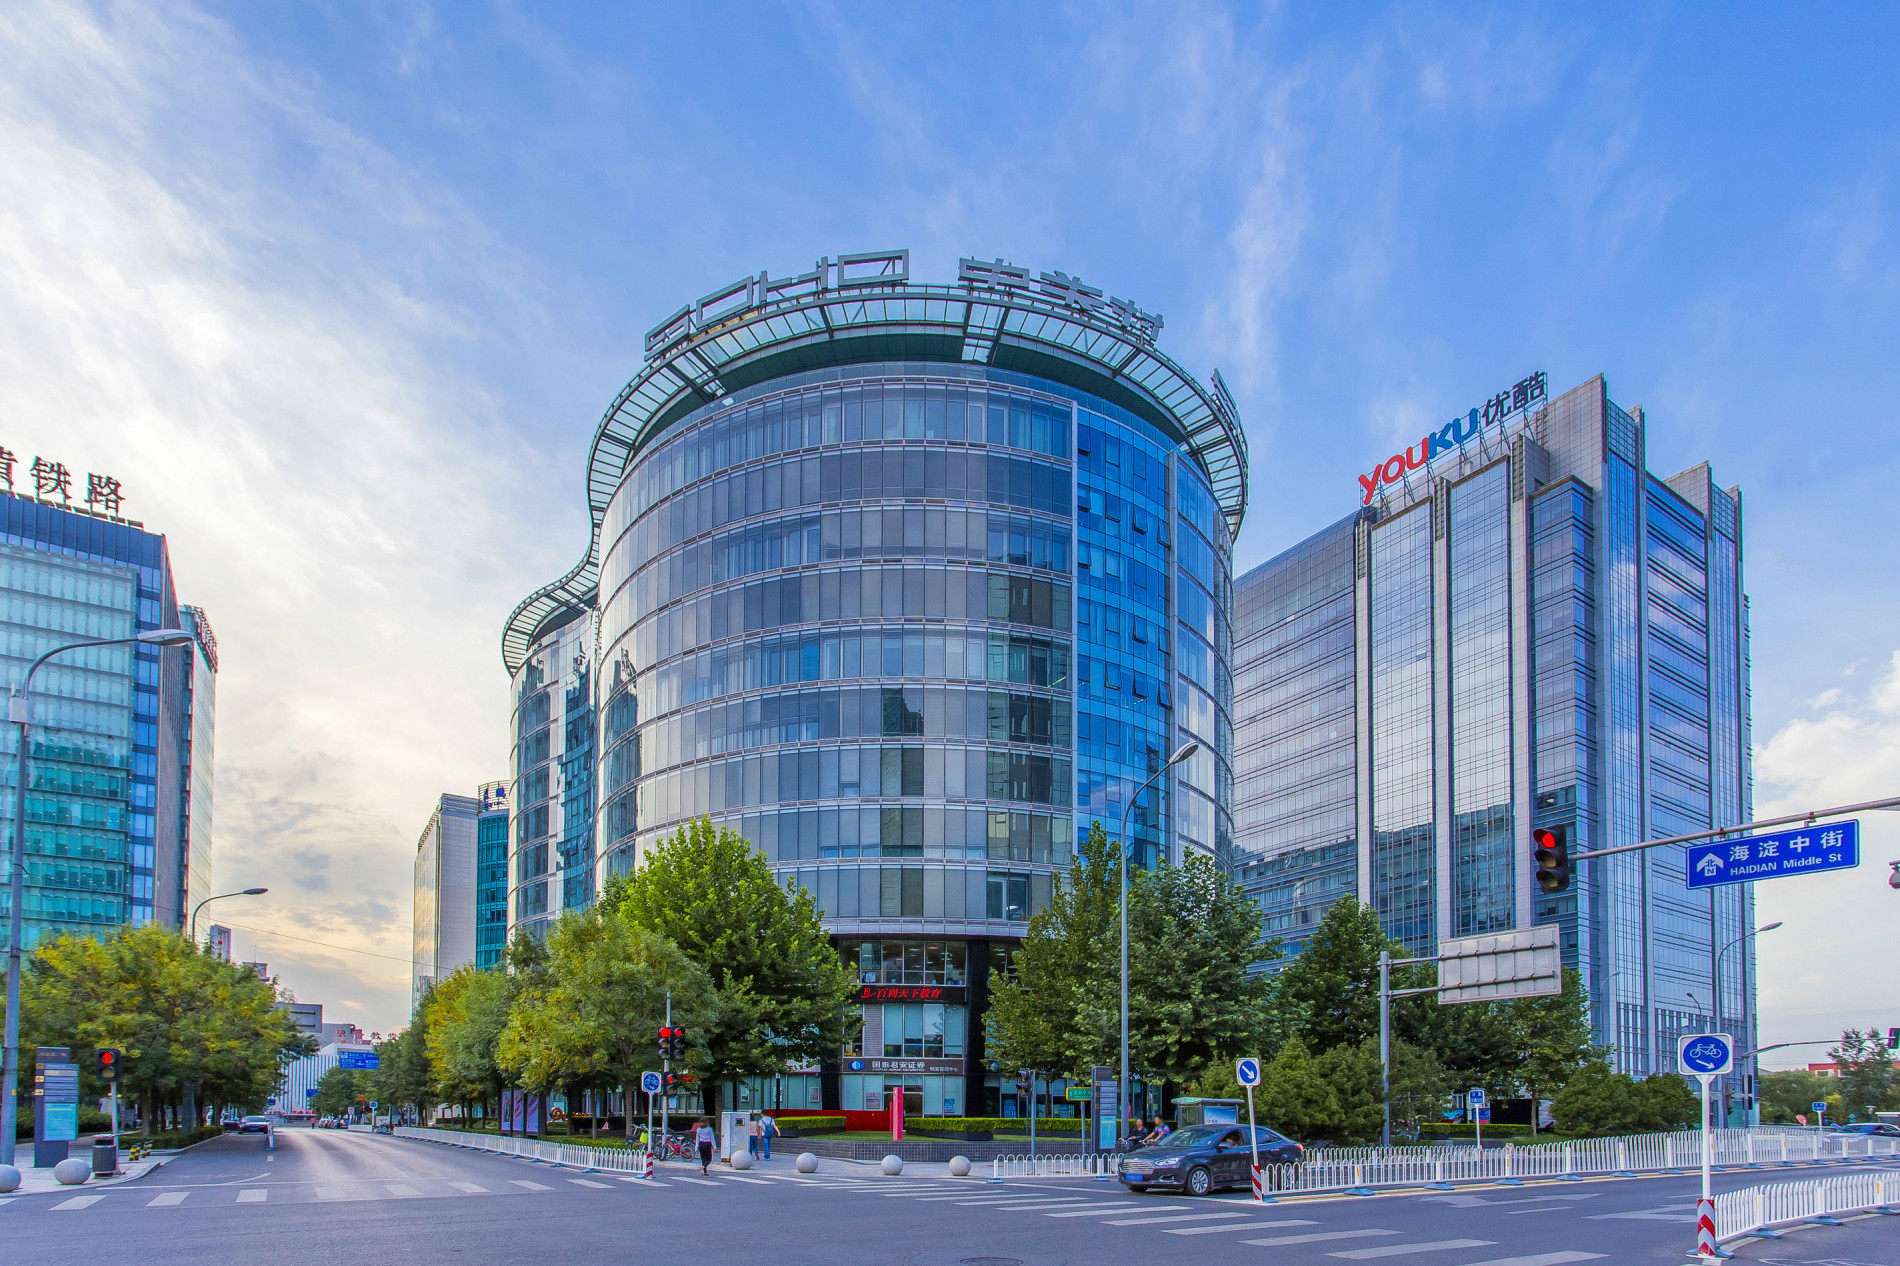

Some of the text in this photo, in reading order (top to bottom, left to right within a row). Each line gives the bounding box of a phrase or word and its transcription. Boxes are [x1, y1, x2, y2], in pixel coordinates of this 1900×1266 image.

[958, 256, 1165, 342] 中关村
[1358, 370, 1546, 506] YOUKU 优酷
[1729, 829, 1844, 862] 海淀中街
[1730, 853, 1842, 876] HAIDIAN Middle St
[876, 987, 942, 999] 百利天下教育
[871, 1060, 926, 1069] 国泰君安证券
